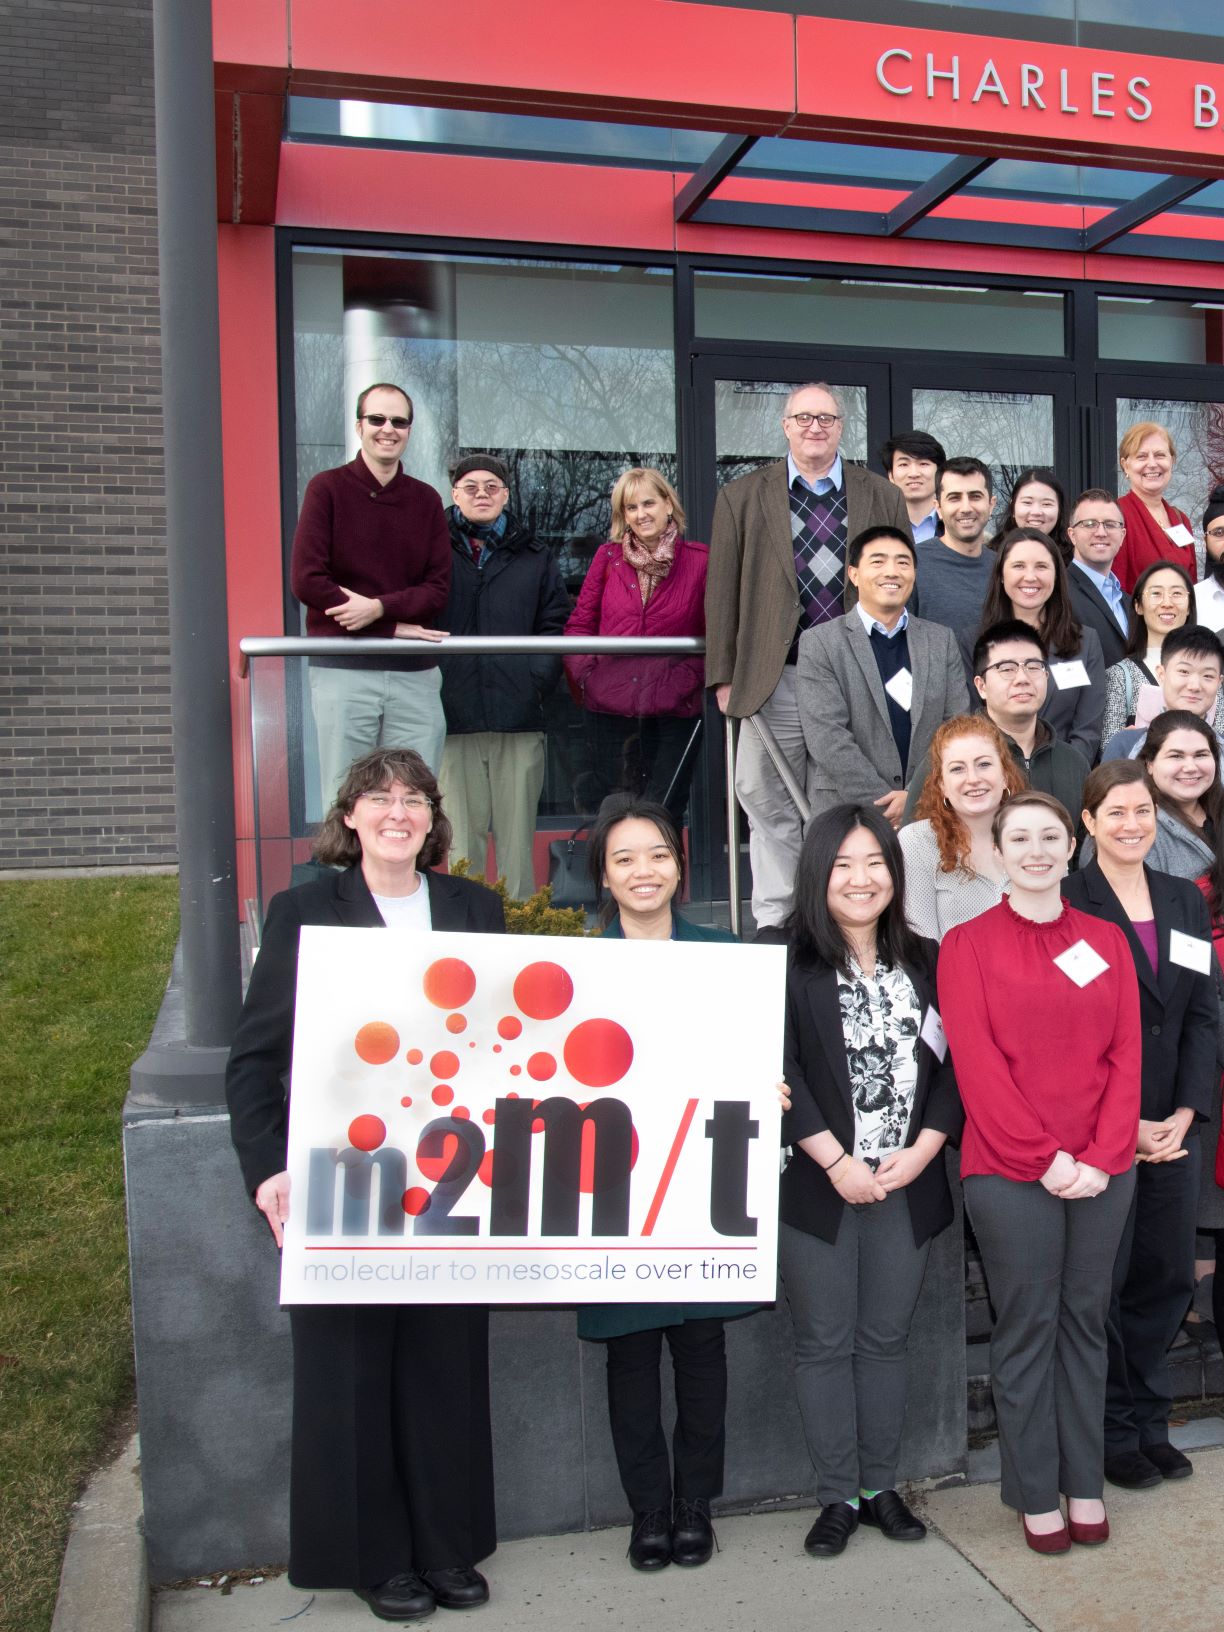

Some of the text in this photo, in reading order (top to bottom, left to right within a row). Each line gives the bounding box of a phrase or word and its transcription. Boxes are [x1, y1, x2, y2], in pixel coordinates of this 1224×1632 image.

[876, 48, 1153, 122] CHARLES
[303, 1255, 758, 1281] molecular to mesoscale over time
